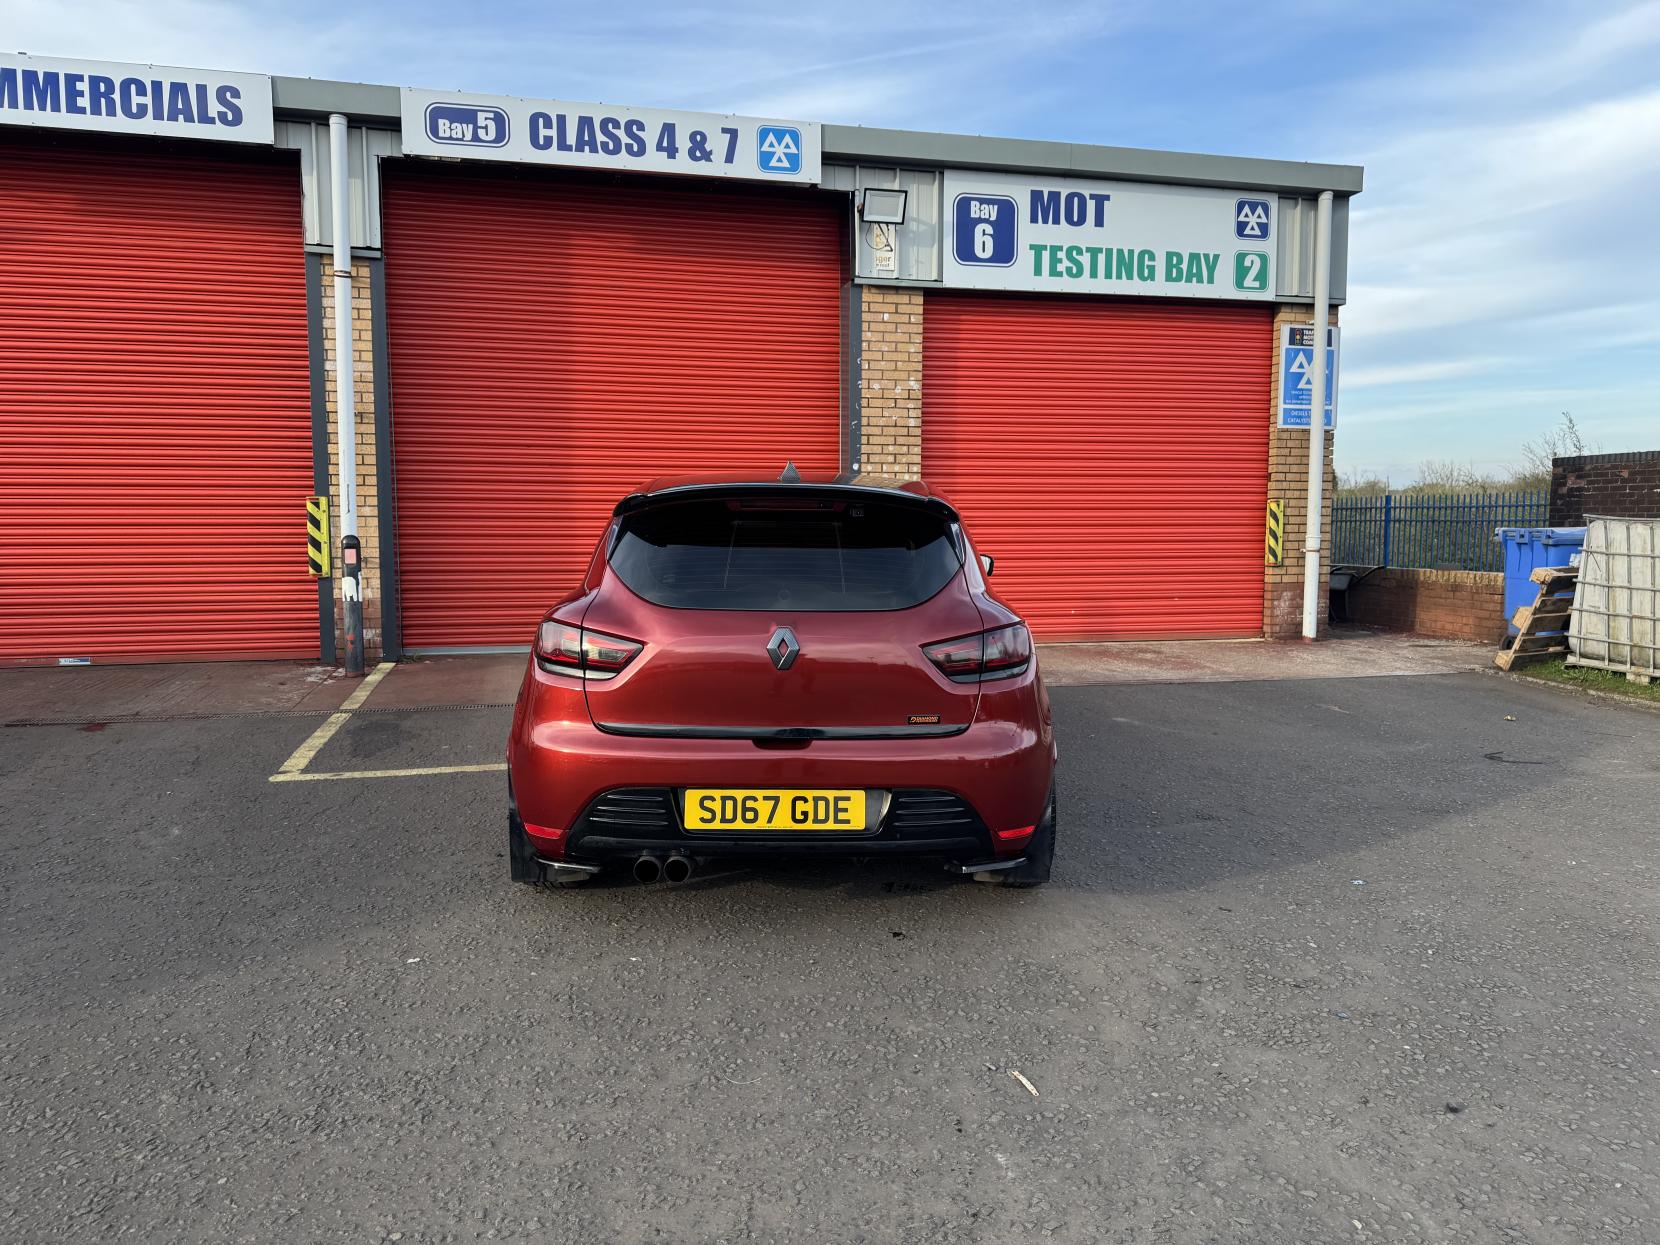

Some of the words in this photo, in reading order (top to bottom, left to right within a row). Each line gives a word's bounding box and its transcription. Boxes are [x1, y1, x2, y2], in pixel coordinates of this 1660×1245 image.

[438, 118, 473, 141] Bay
[477, 112, 496, 141] 5
[529, 112, 646, 158] CLASS
[656, 122, 679, 160] 4
[687, 130, 713, 163] &
[721, 127, 739, 164] 7
[970, 200, 998, 219] Bay
[1029, 189, 1111, 228] MOT
[974, 223, 994, 259] 6
[1029, 244, 1156, 282] TESTING
[1164, 251, 1221, 284] BAY
[1243, 255, 1262, 288] 2
[699, 796, 780, 824] SD67
[791, 796, 851, 824] GDE
